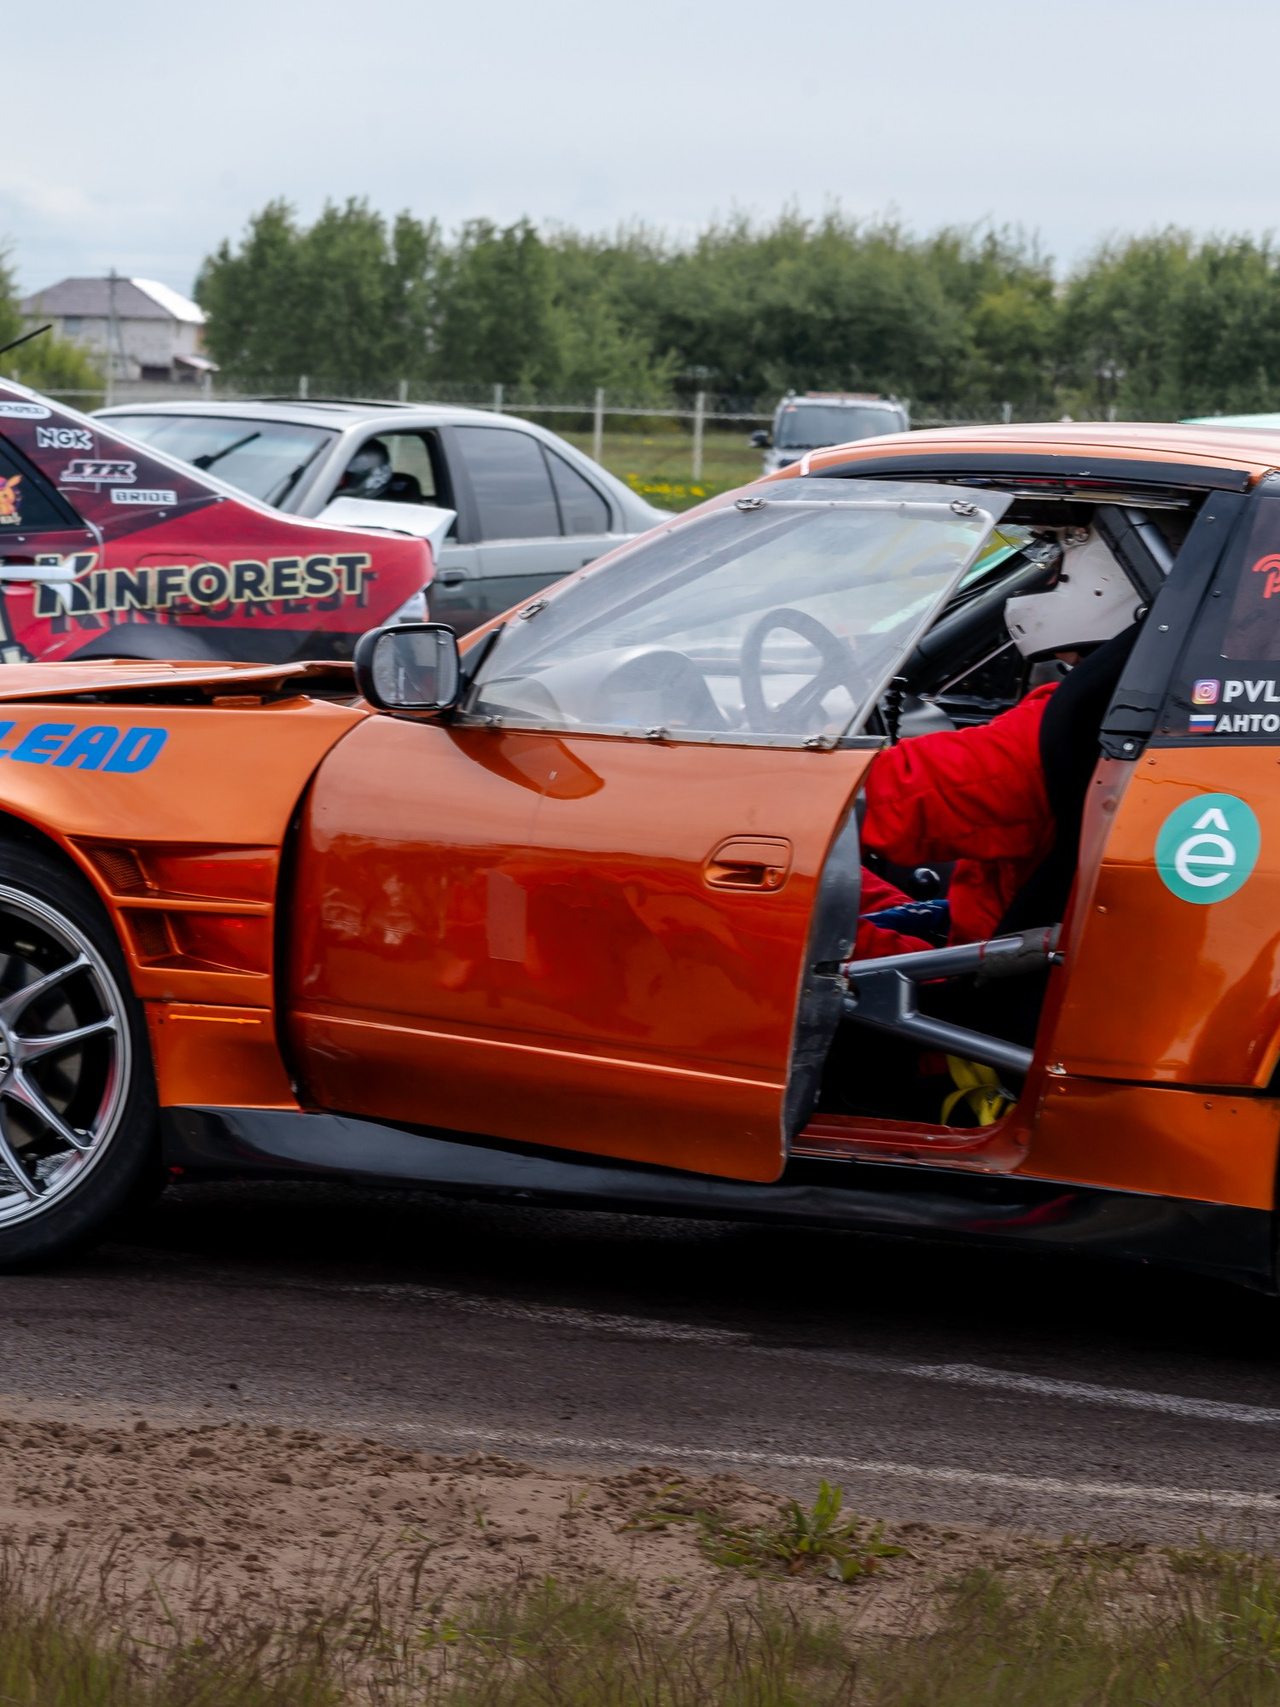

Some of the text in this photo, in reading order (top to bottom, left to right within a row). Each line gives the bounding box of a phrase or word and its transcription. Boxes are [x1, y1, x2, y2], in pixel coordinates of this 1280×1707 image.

[37, 427, 93, 449] NGK
[115, 491, 174, 503] BRIDE
[35, 552, 371, 618] KINFOREST
